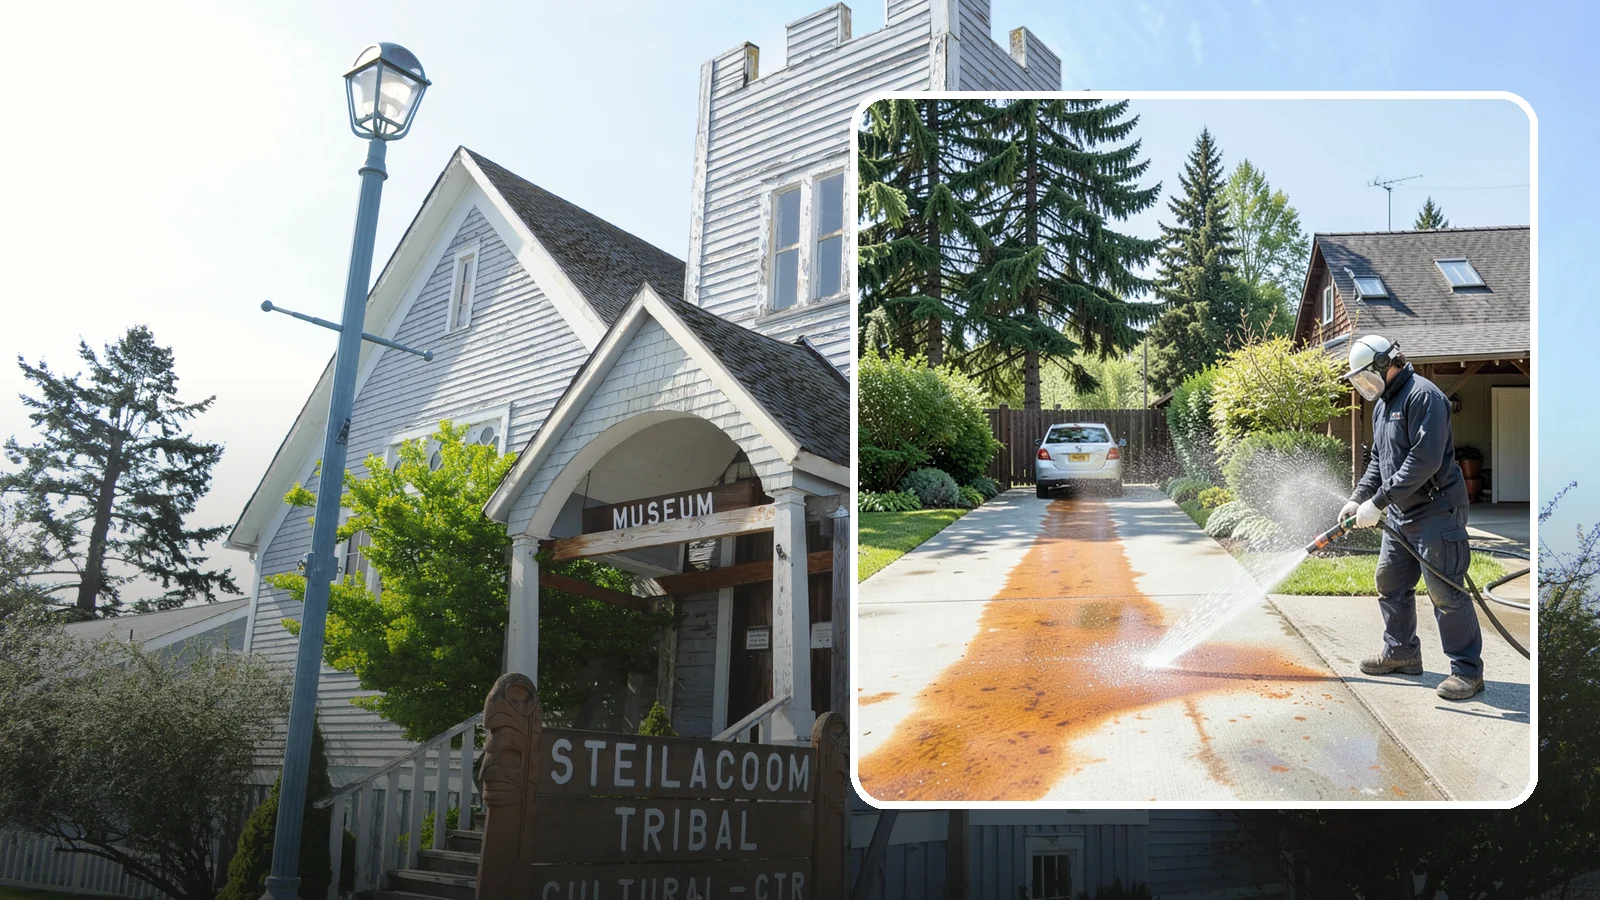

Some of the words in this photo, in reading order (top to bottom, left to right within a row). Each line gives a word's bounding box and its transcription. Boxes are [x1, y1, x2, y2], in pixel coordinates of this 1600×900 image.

[613, 491, 714, 531] MUSEUM
[550, 738, 810, 792] STEILACOOM
[615, 807, 758, 852] TRIBAL
[755, 871, 805, 900] CTR
